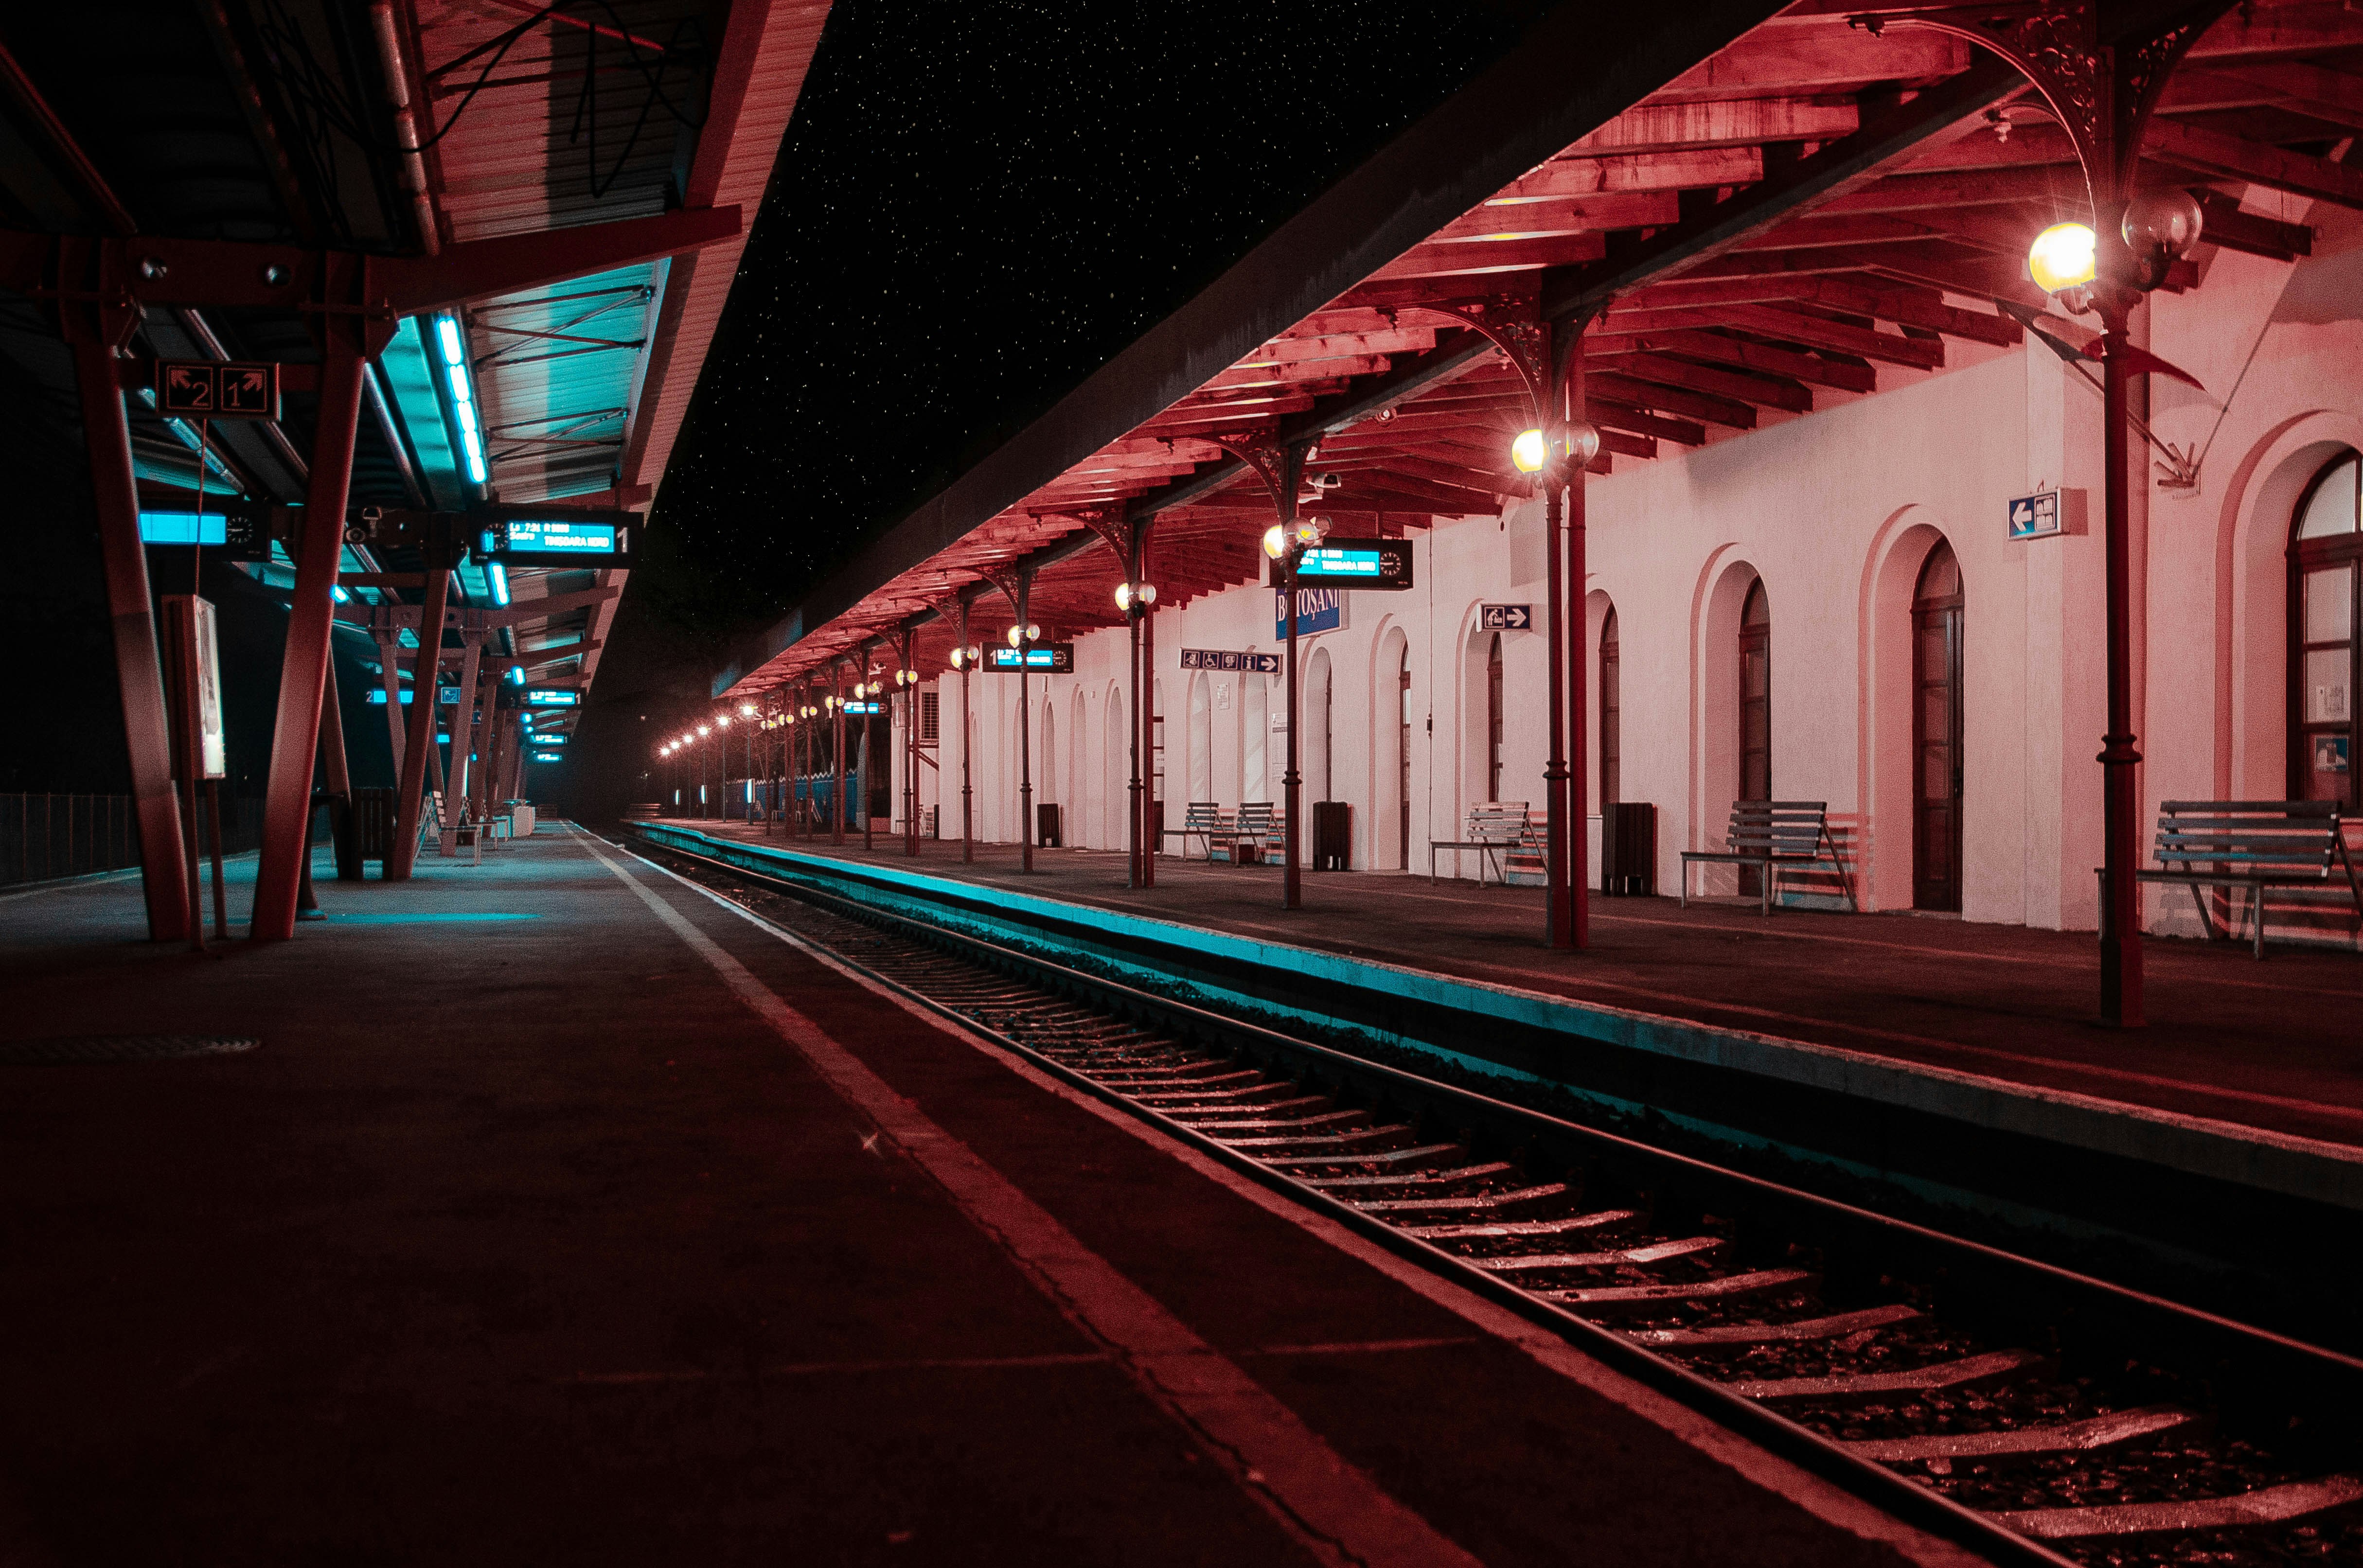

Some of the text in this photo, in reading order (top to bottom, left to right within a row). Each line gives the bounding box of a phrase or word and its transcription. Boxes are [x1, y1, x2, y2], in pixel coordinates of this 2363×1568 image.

[192, 382, 240, 406] 2 1
[617, 527, 628, 553] 1
[990, 650, 996, 665] 1
[366, 690, 373, 703] 2
[575, 693, 581, 705] 1
